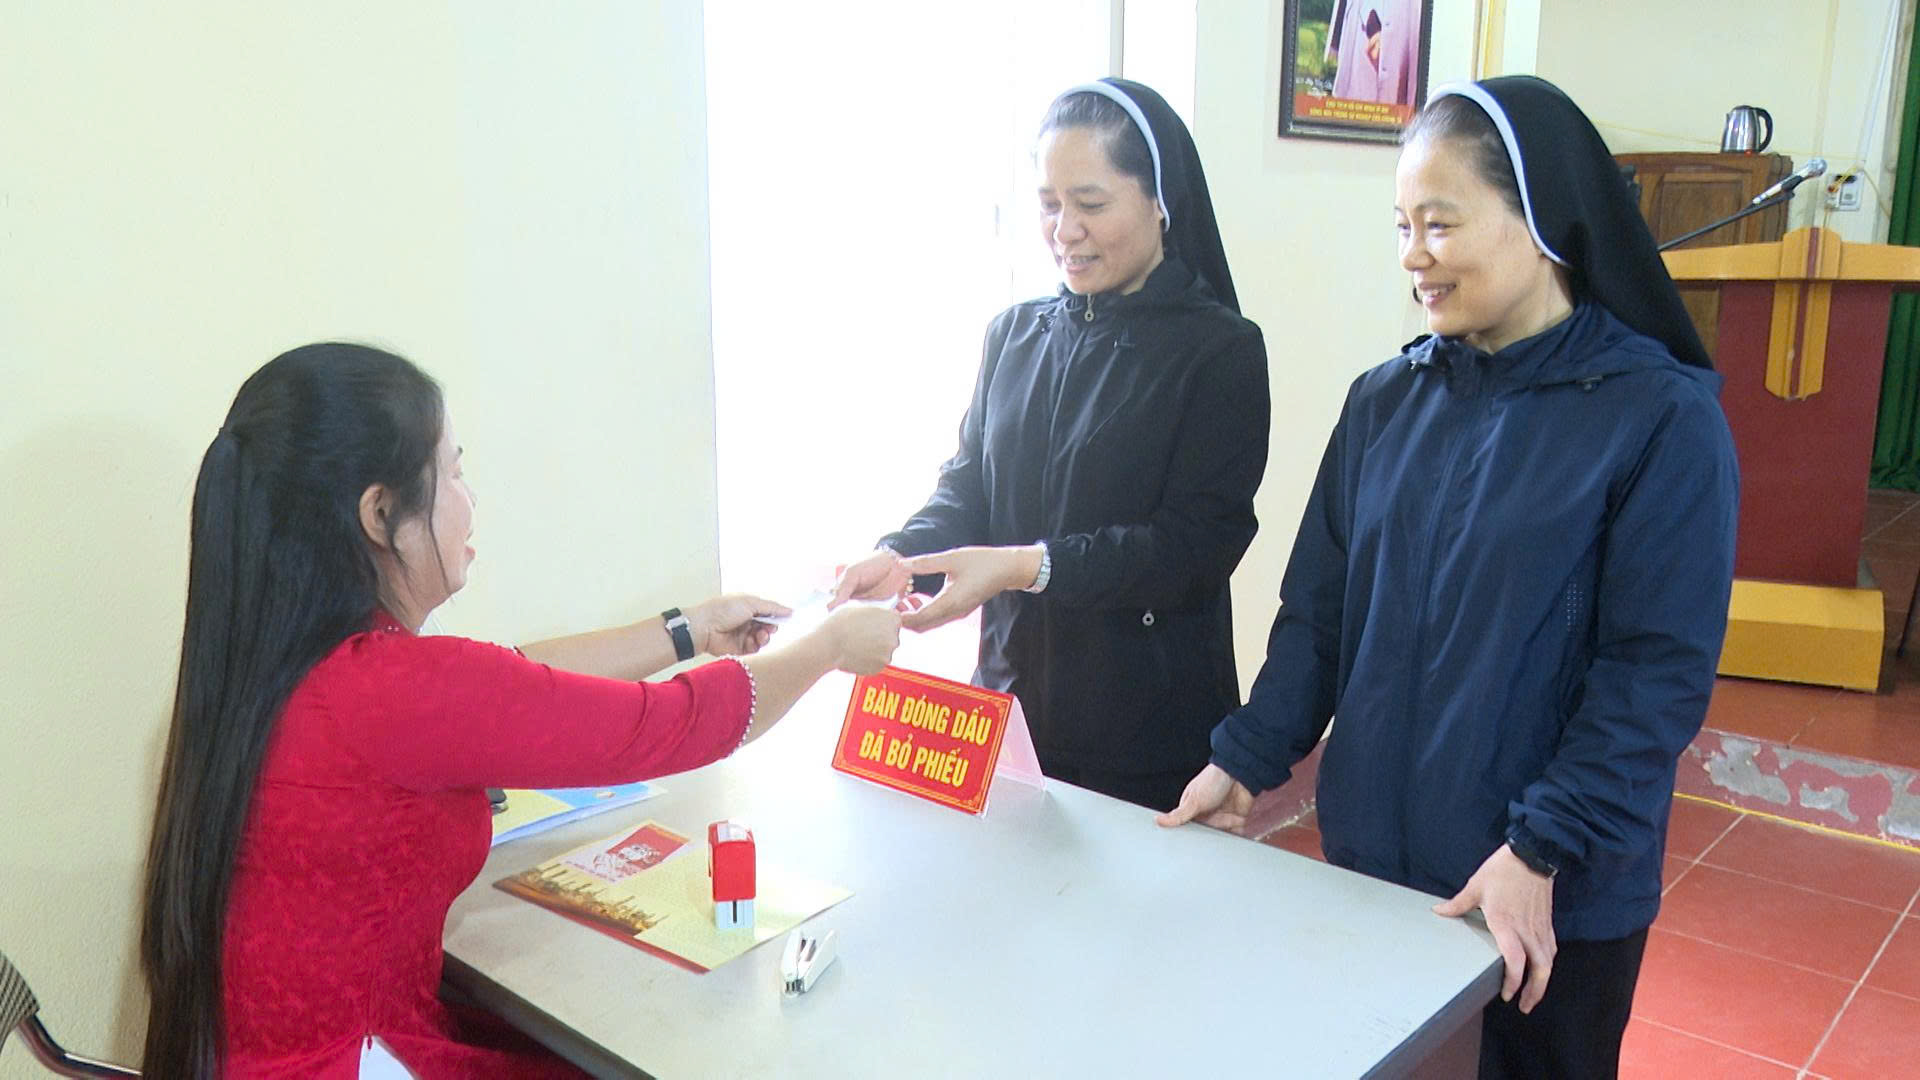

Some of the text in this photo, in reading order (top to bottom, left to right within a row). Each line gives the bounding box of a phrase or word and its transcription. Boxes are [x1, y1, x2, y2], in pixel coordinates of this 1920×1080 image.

[862, 683, 992, 746] BÀN ĐÓNG DẤU
[858, 729, 970, 788] ĐÃ BỎ PHIẾU
